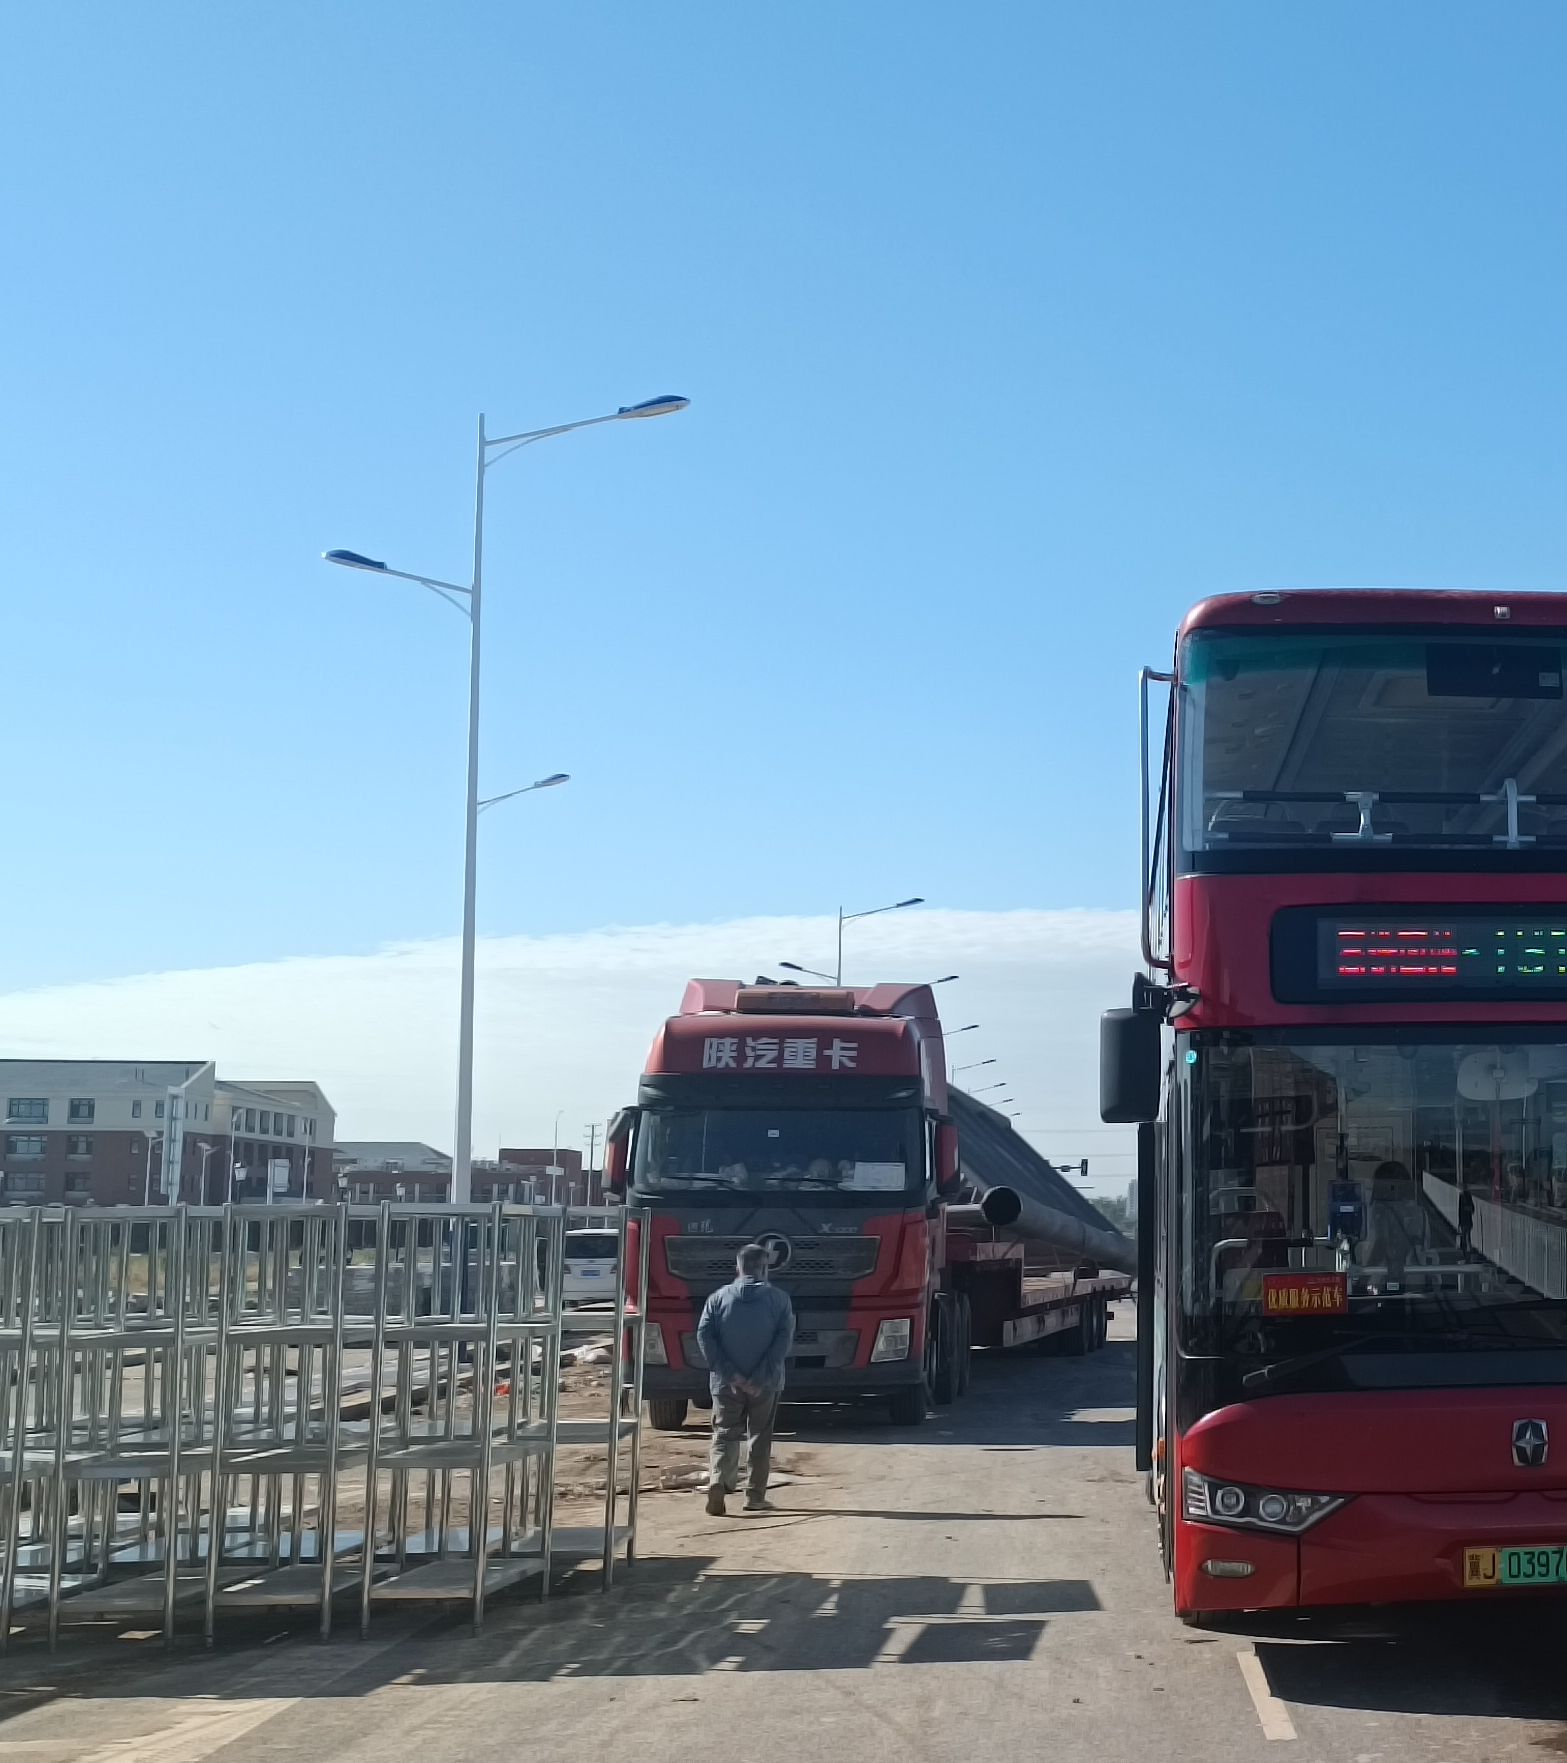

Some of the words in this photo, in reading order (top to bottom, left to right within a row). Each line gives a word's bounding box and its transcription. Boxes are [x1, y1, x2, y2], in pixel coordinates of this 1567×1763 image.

[703, 1037, 859, 1070] 陕汽重卡
[1267, 1285, 1343, 1310] 优质服务示范车
